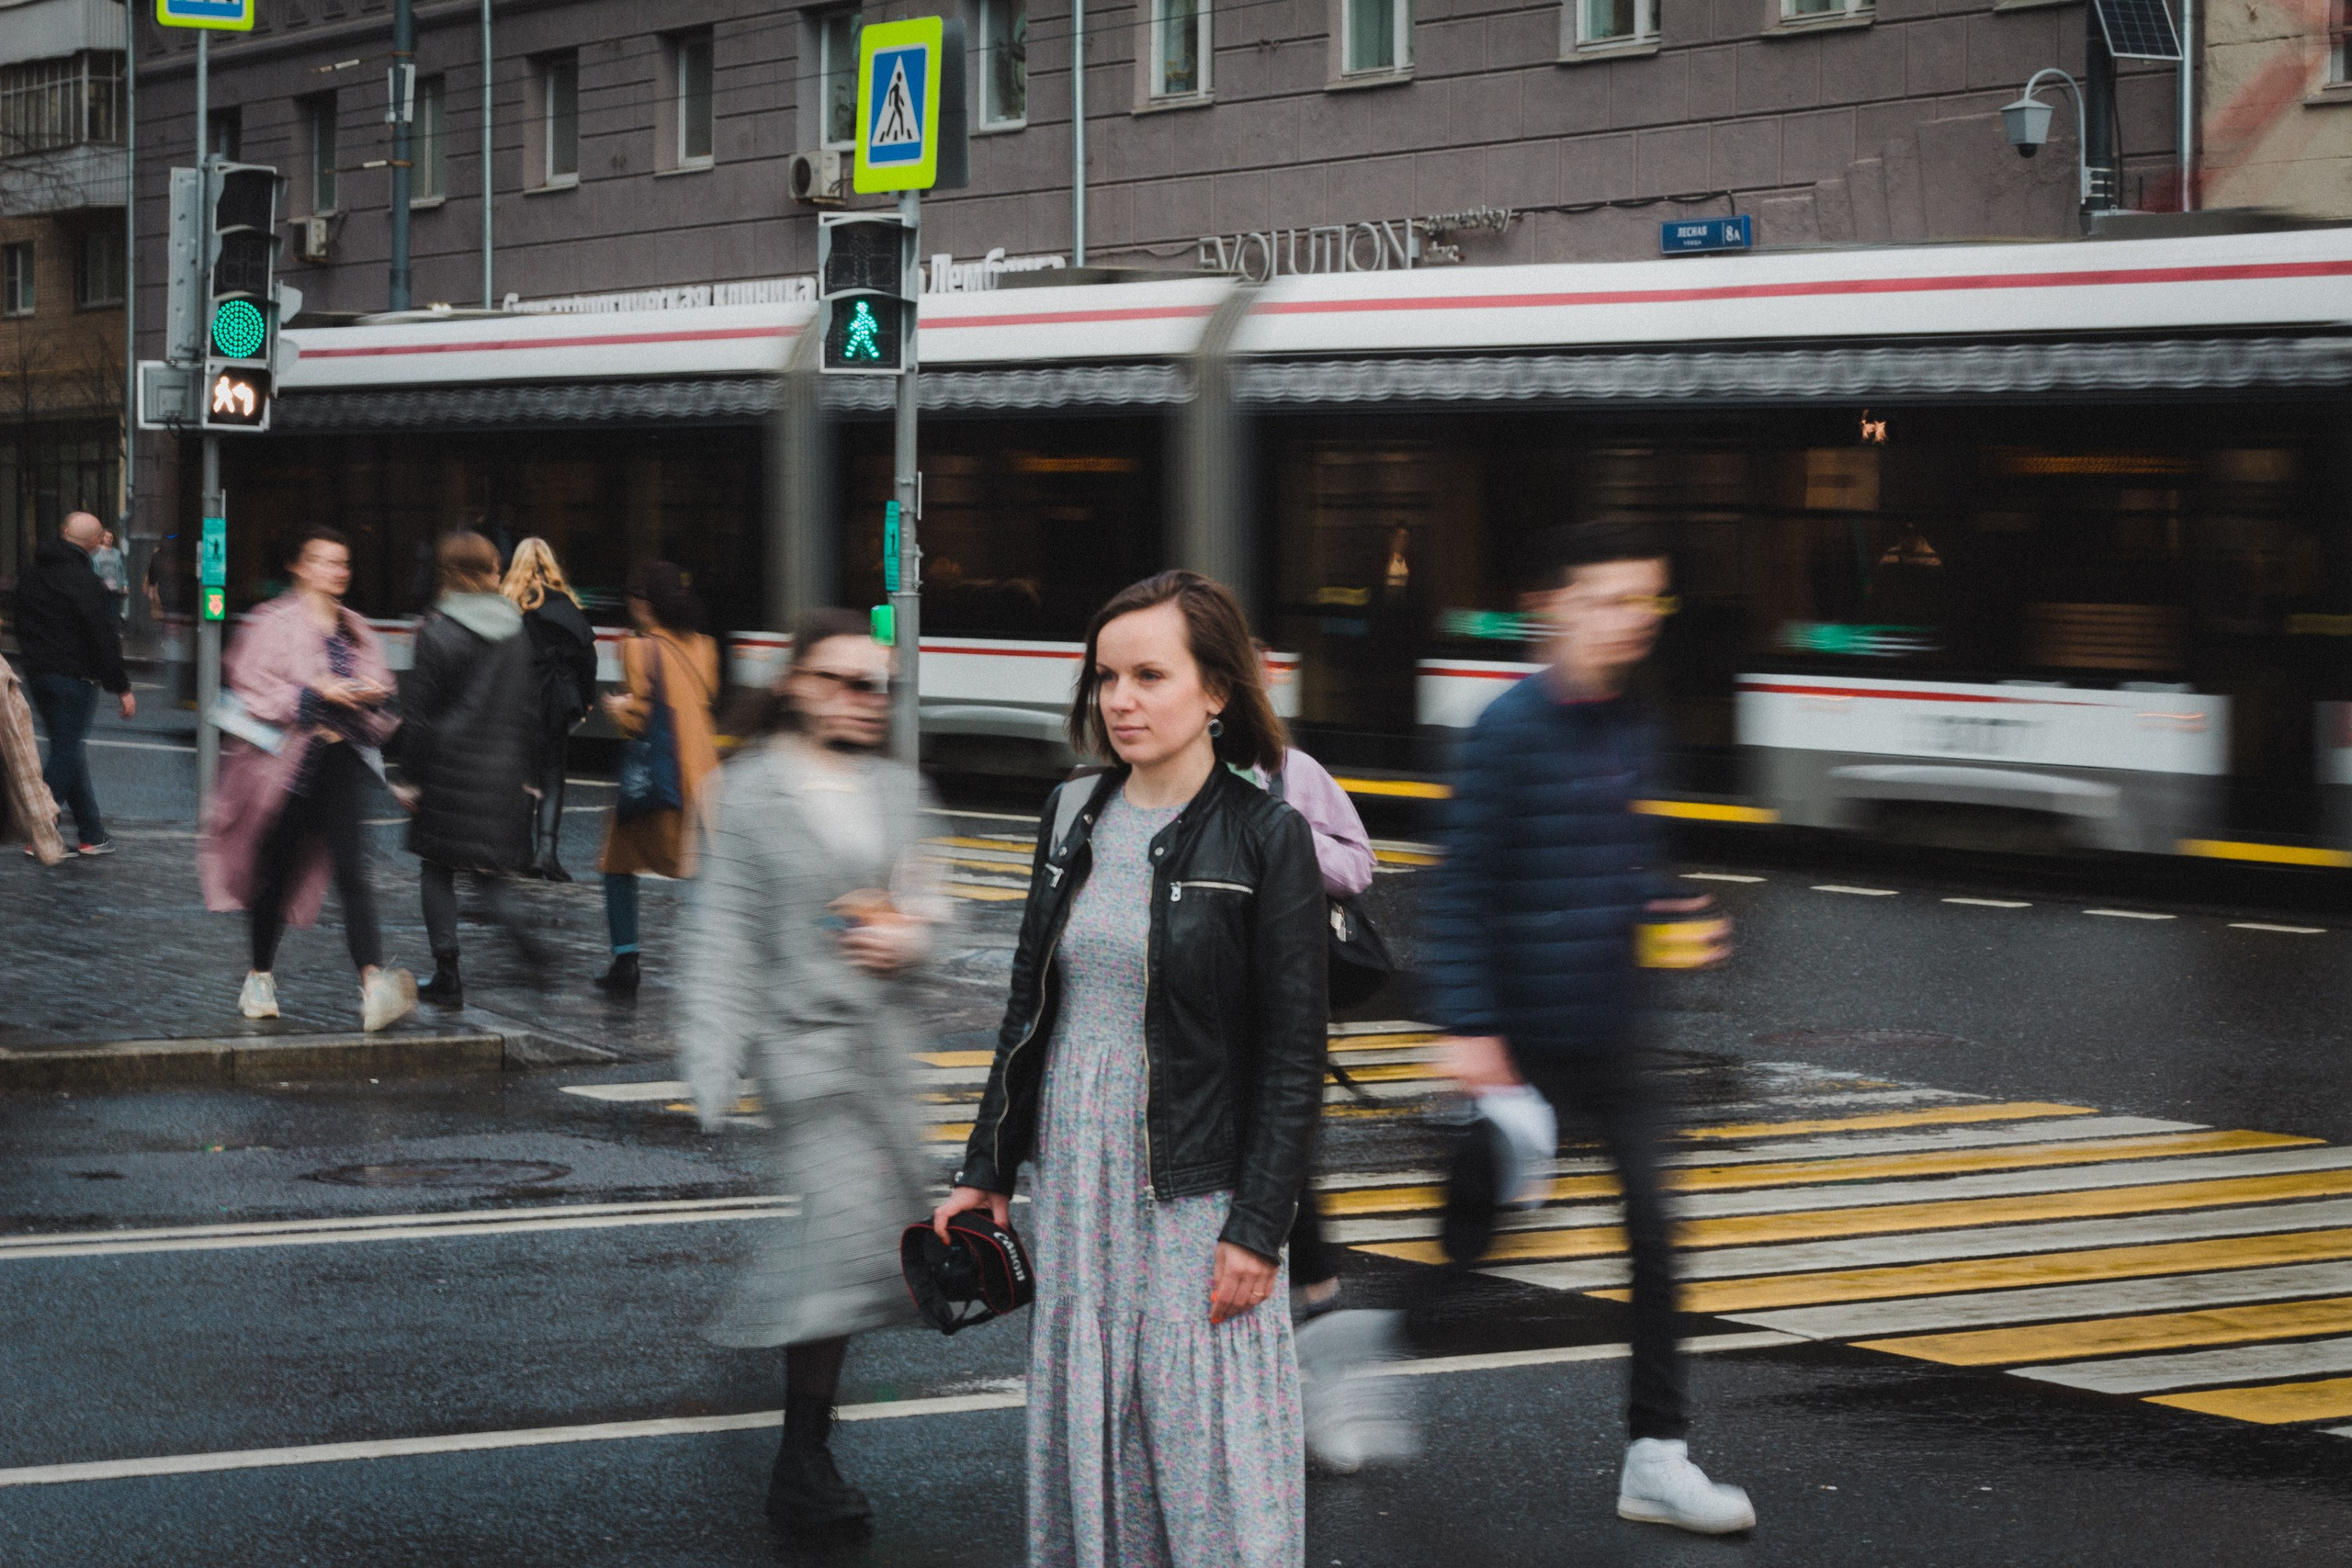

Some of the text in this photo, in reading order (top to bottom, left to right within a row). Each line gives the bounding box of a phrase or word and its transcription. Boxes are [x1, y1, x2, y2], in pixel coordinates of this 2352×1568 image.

[1198, 219, 1412, 281] EVOLUTION
[1678, 226, 1707, 237] ЛЕСНАЯ
[993, 1232, 1025, 1281] Canon
